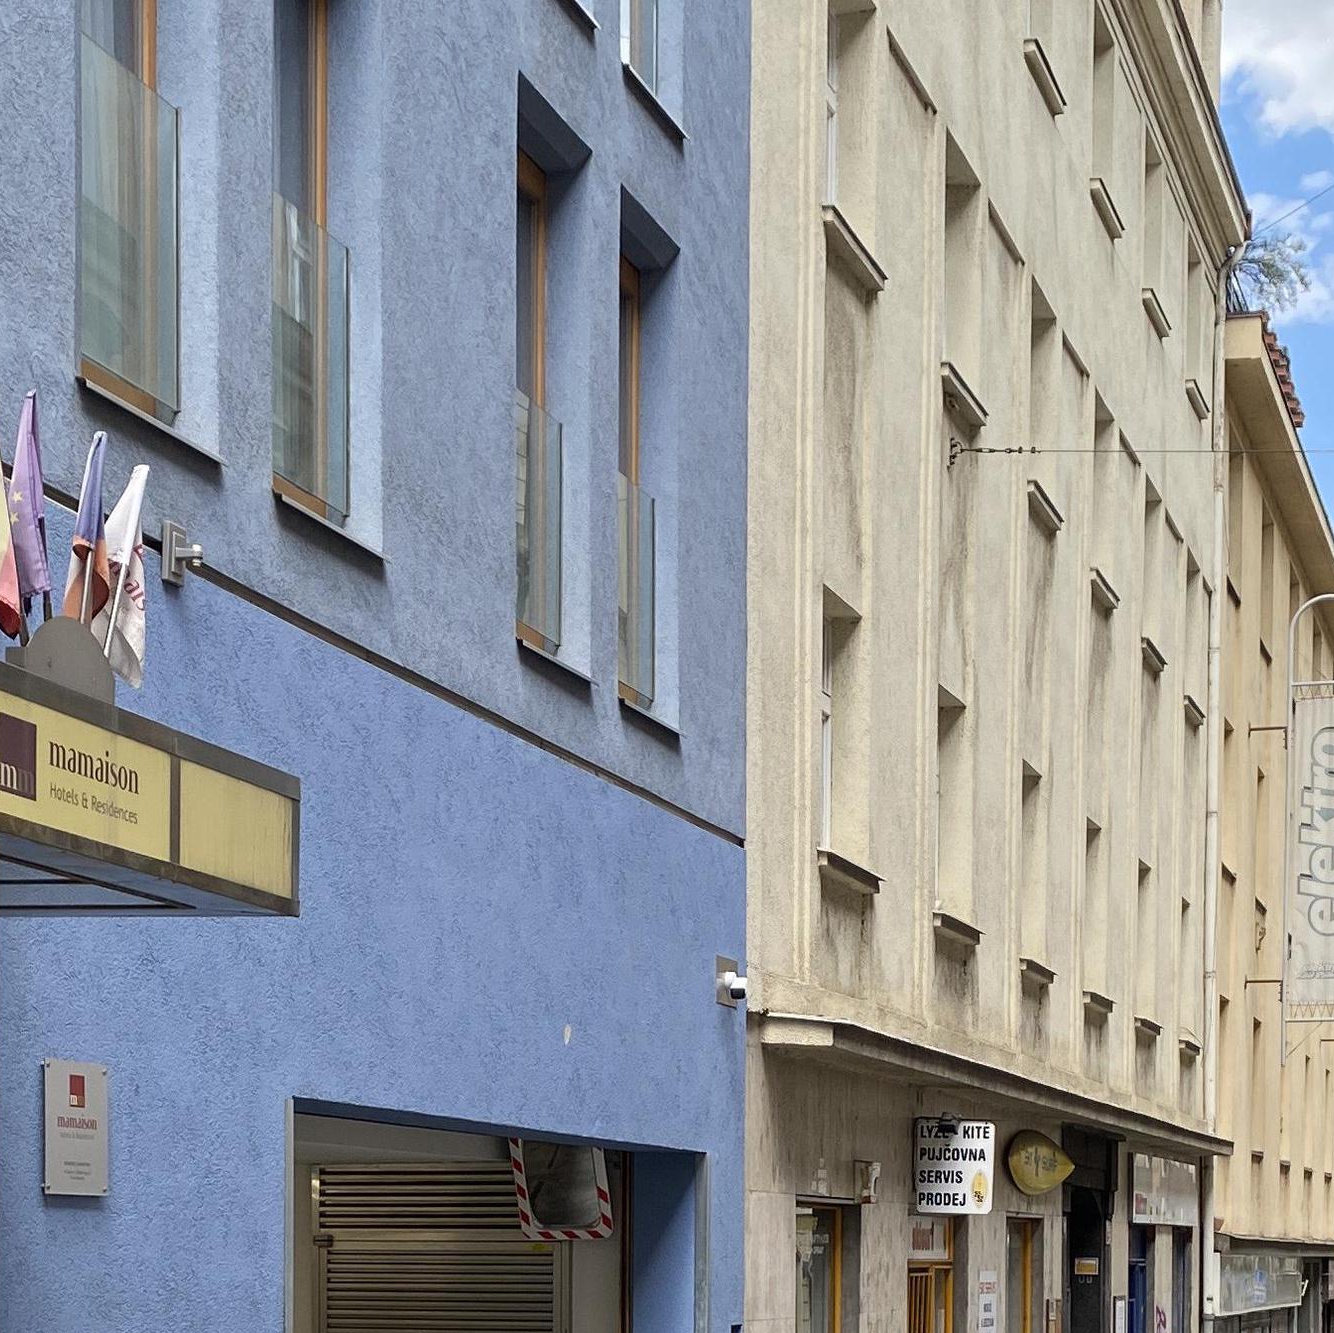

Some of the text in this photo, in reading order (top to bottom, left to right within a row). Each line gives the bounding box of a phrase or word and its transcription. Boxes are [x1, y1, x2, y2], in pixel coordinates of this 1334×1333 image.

[48, 741, 140, 795] mamaison
[49, 782, 138, 825] Hotels & Residences
[962, 1125, 991, 1139] KITE
[918, 1169, 964, 1184] SERVIS
[918, 1191, 967, 1207] PRODEJ
